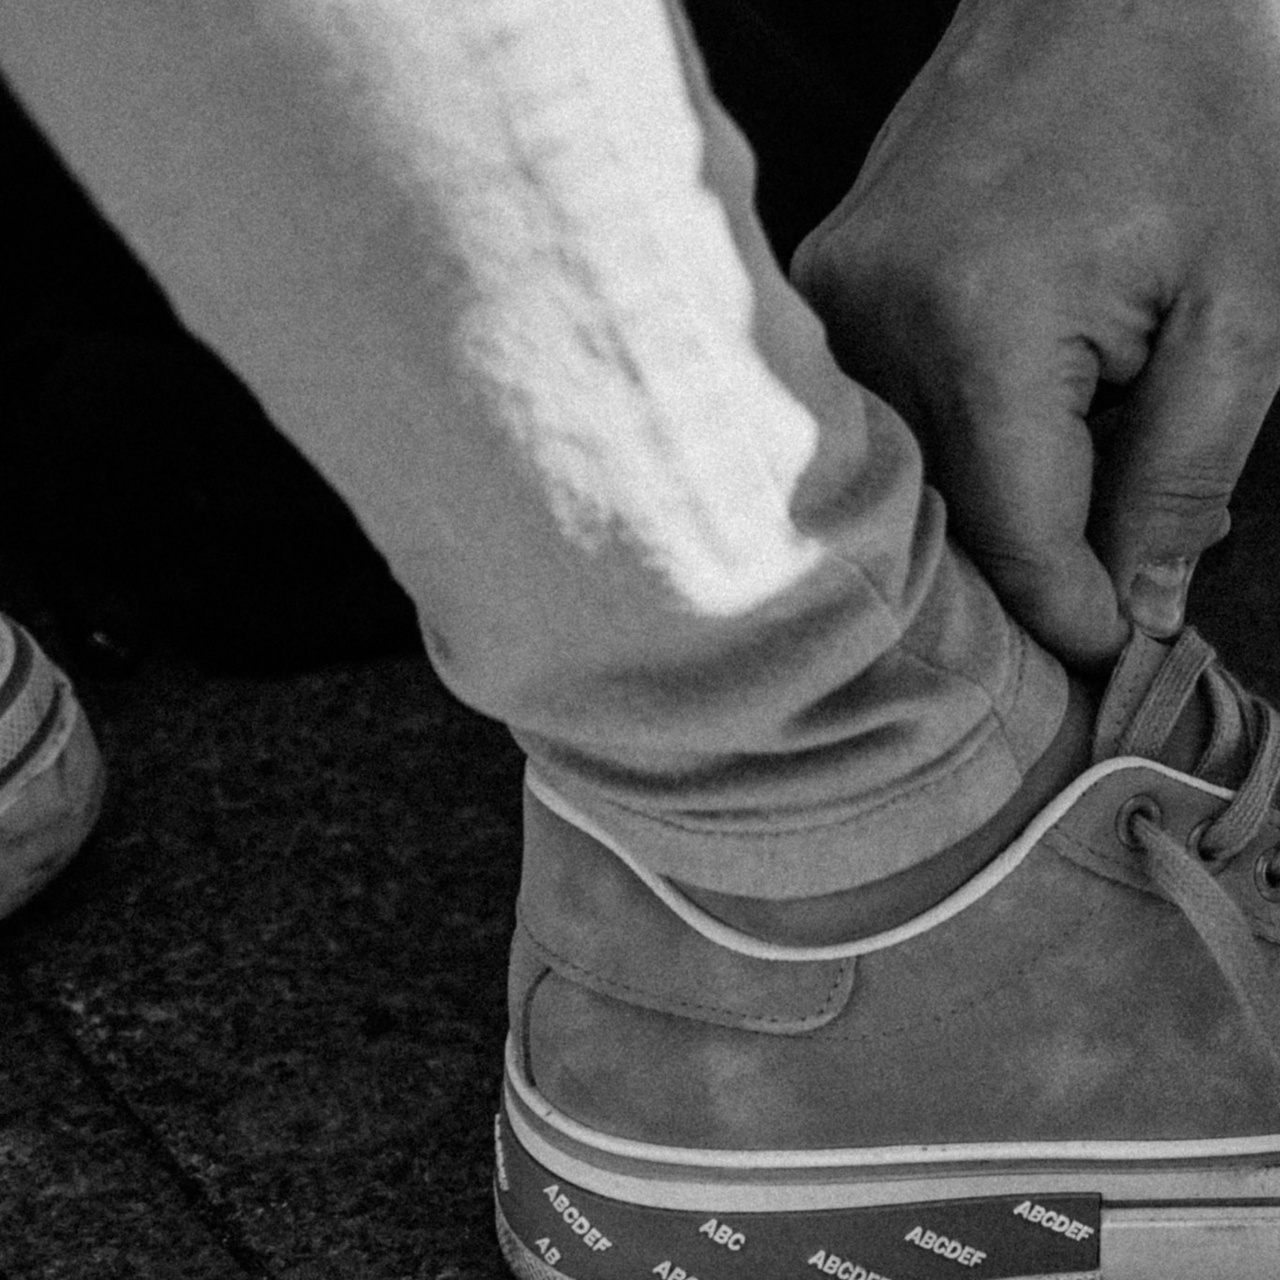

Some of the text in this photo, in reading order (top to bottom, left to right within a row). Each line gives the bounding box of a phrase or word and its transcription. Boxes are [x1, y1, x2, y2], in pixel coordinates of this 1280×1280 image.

[543, 1184, 613, 1251] ABCDEF
[698, 1218, 746, 1251] ABC
[1013, 1200, 1095, 1242] ABCDEF
[535, 1237, 562, 1265] AB
[904, 1226, 988, 1268] ABCDEF
